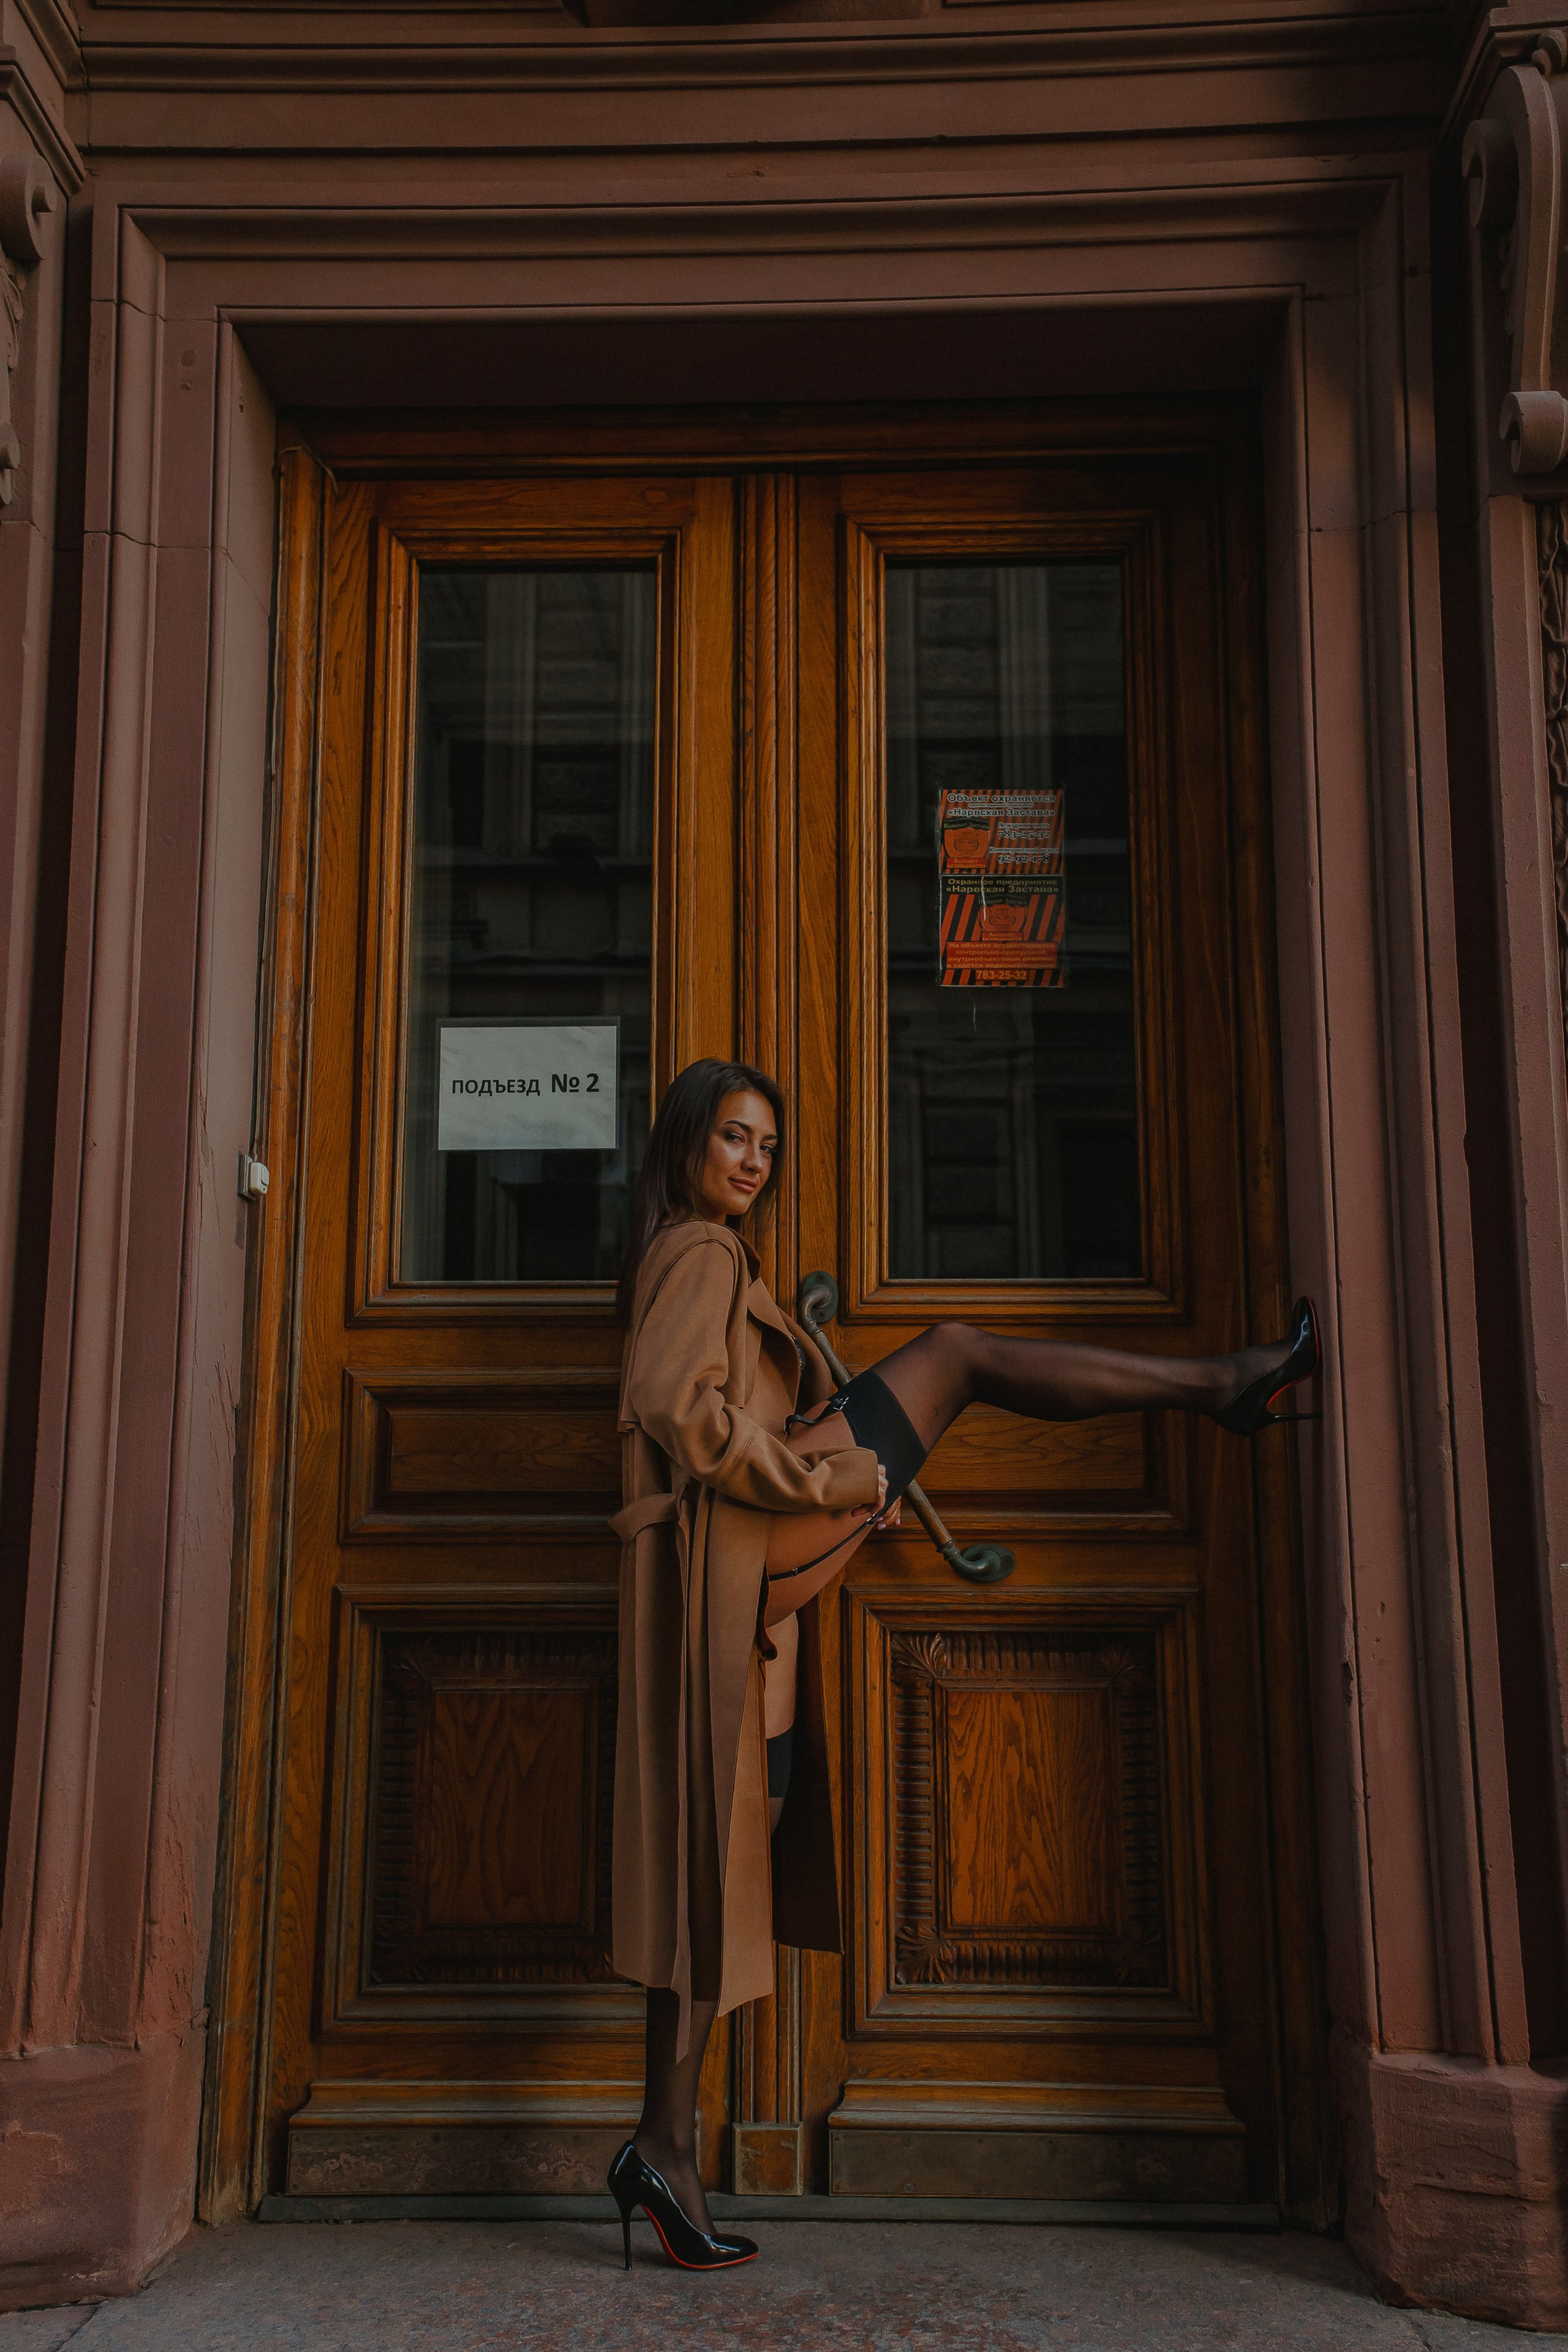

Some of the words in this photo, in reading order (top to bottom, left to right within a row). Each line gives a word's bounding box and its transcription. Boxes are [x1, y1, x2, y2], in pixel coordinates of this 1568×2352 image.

[948, 794, 989, 802] Объект
[992, 796, 1055, 804] охраняется
[948, 808, 1004, 818] «Нарвская
[998, 829, 1050, 840] 783-25-32
[998, 854, 1050, 864] 92-92-178
[976, 970, 1027, 979] 783-25-32
